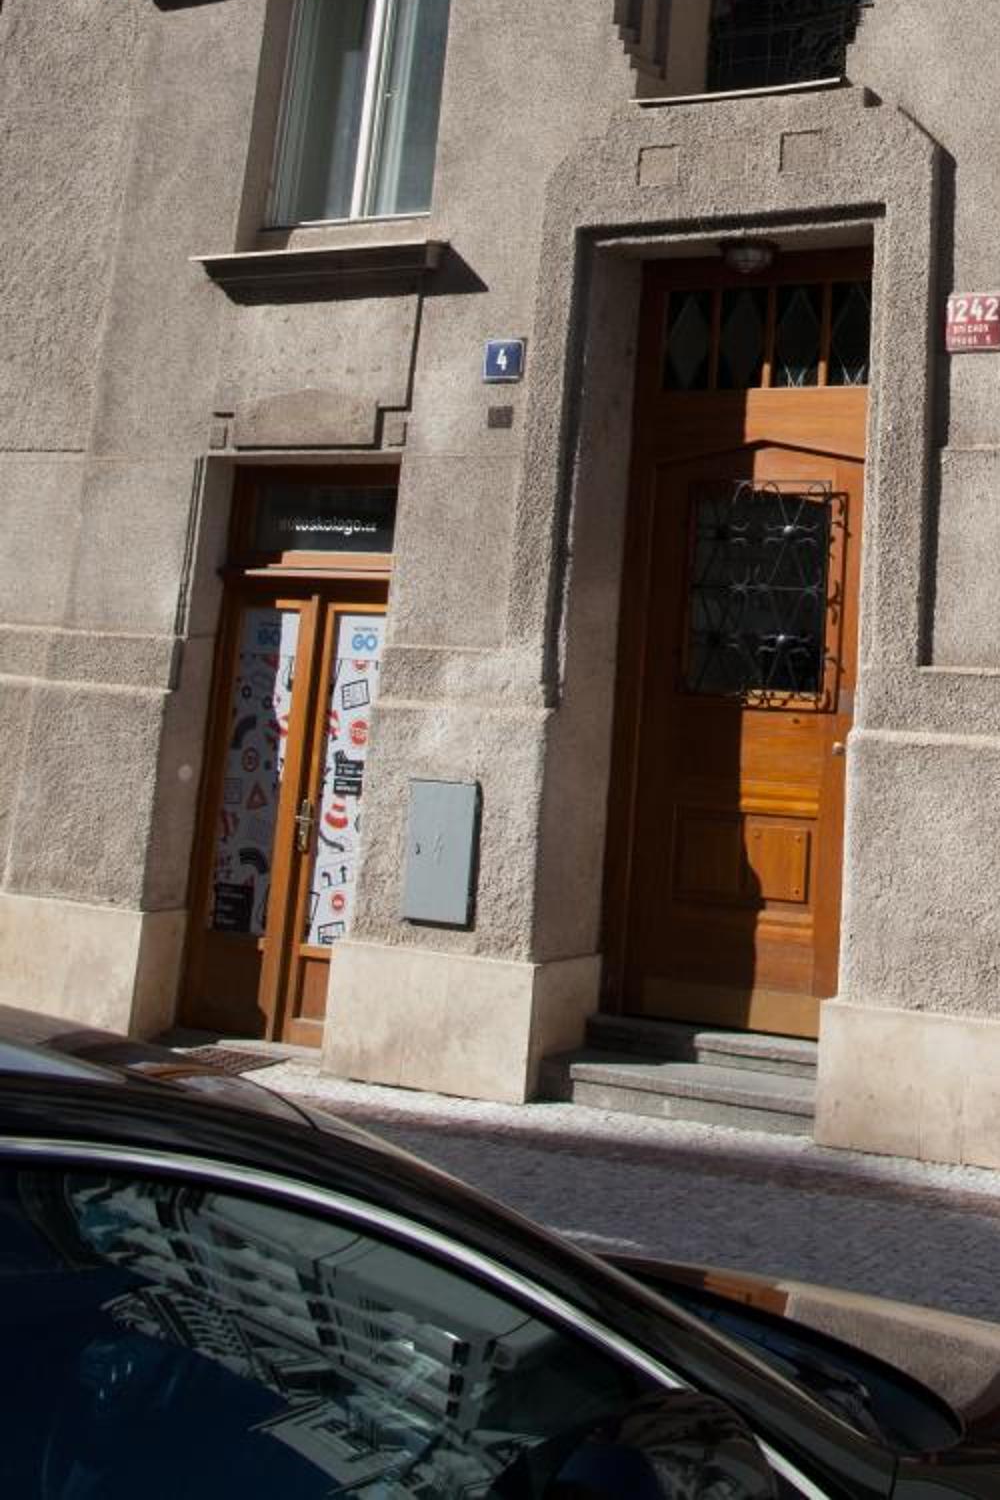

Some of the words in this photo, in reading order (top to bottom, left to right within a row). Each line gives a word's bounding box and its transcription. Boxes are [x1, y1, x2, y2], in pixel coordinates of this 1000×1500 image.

[946, 298, 999, 323] 1242
[495, 347, 508, 371] 4
[352, 633, 378, 651] GO
